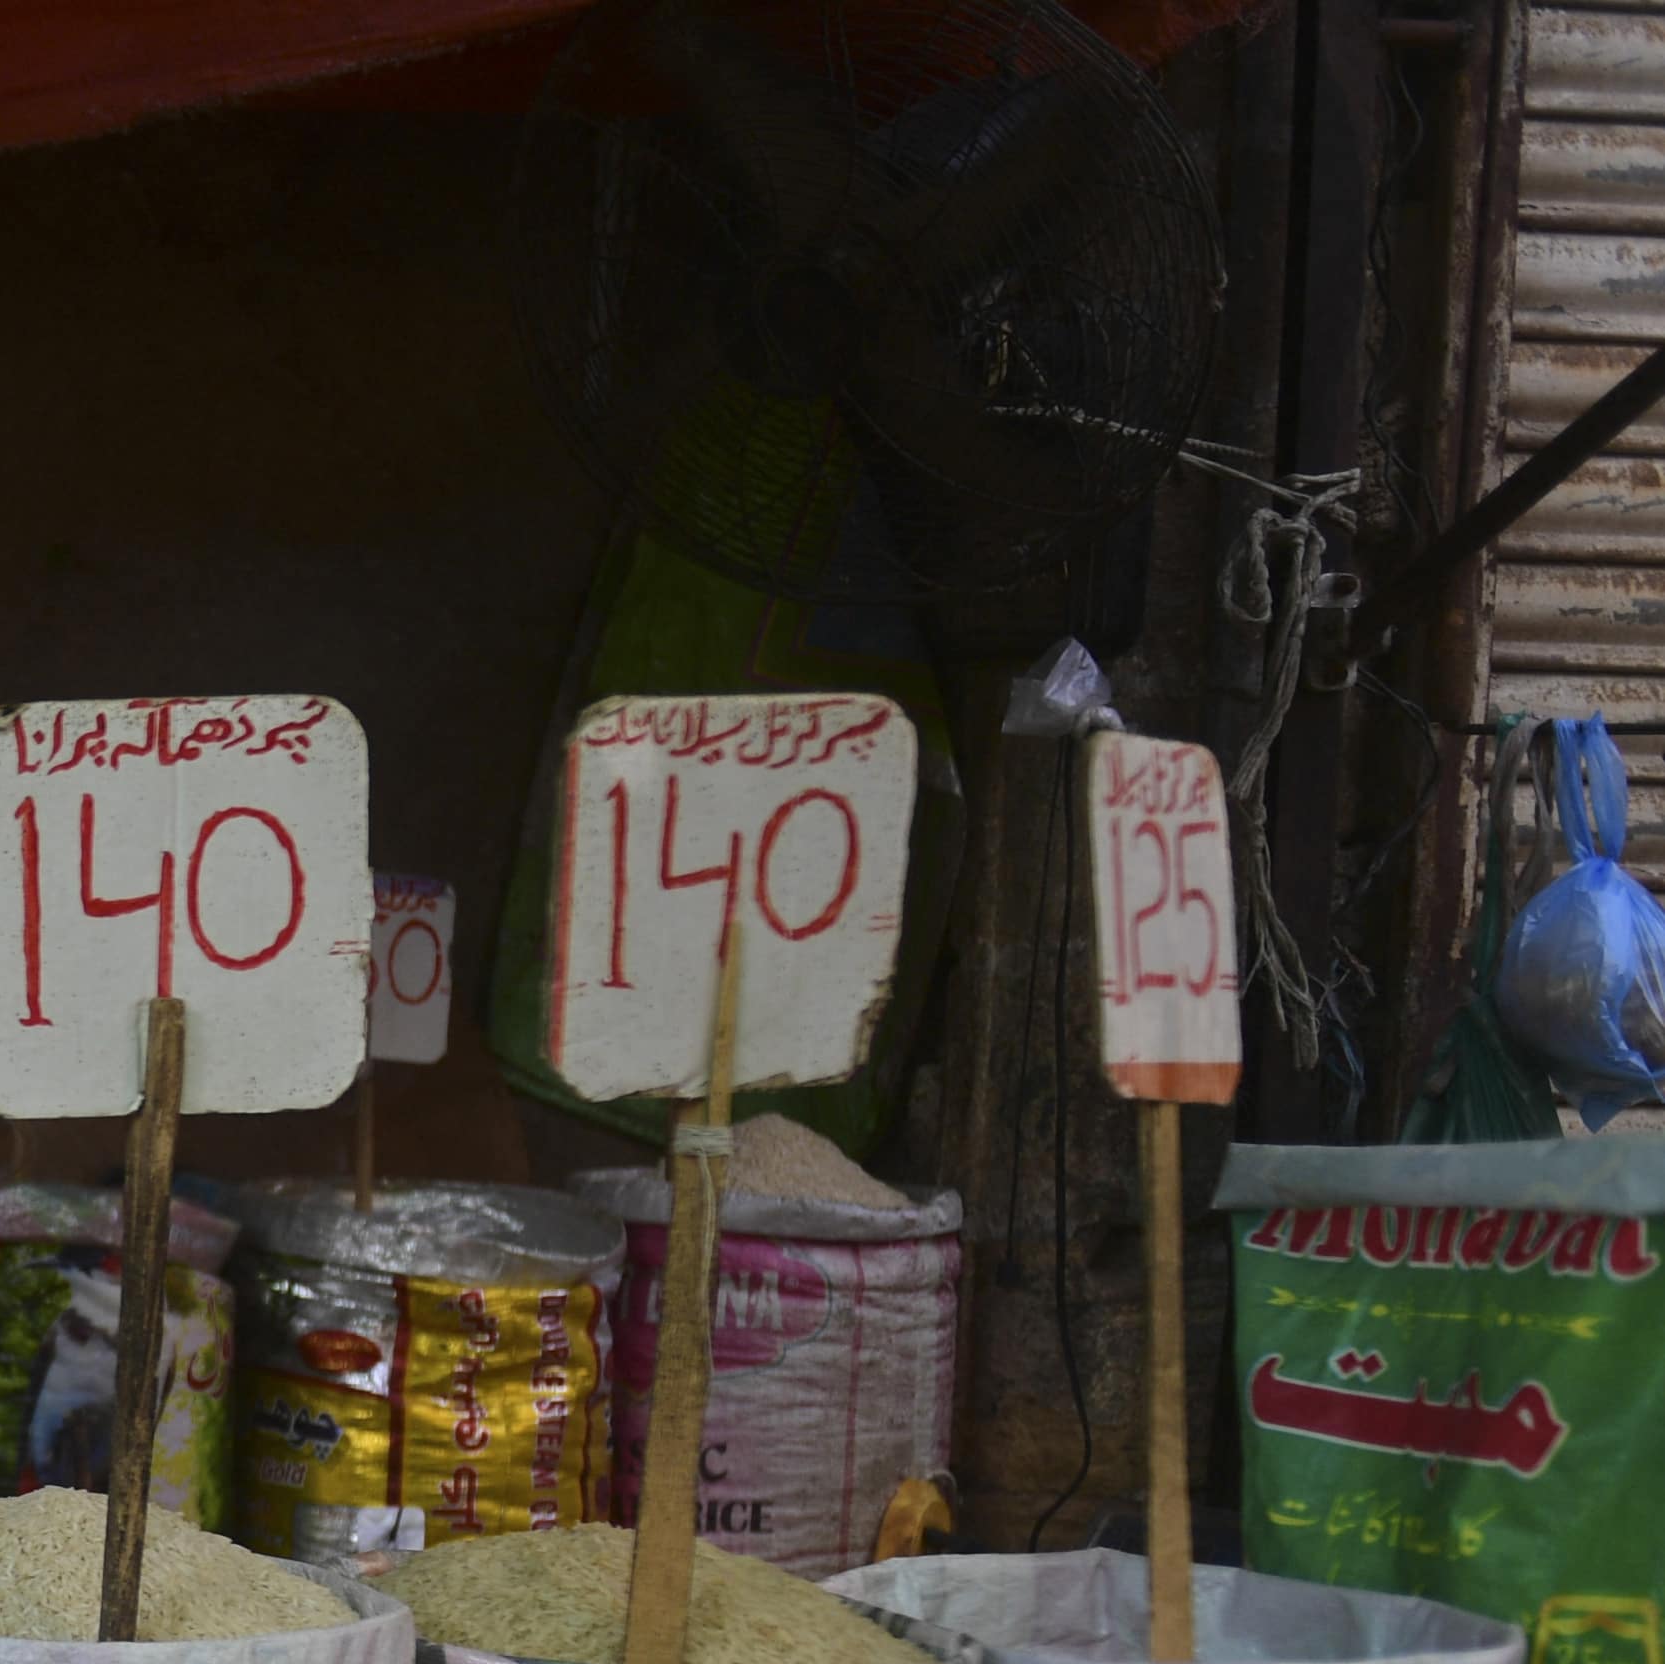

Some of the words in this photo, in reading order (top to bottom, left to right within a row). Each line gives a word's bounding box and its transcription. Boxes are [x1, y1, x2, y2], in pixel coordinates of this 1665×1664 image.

[14, 793, 306, 1028] 140
[601, 773, 860, 989] 140
[1107, 815, 1219, 1006] 125
[695, 1498, 775, 1536] ICE
